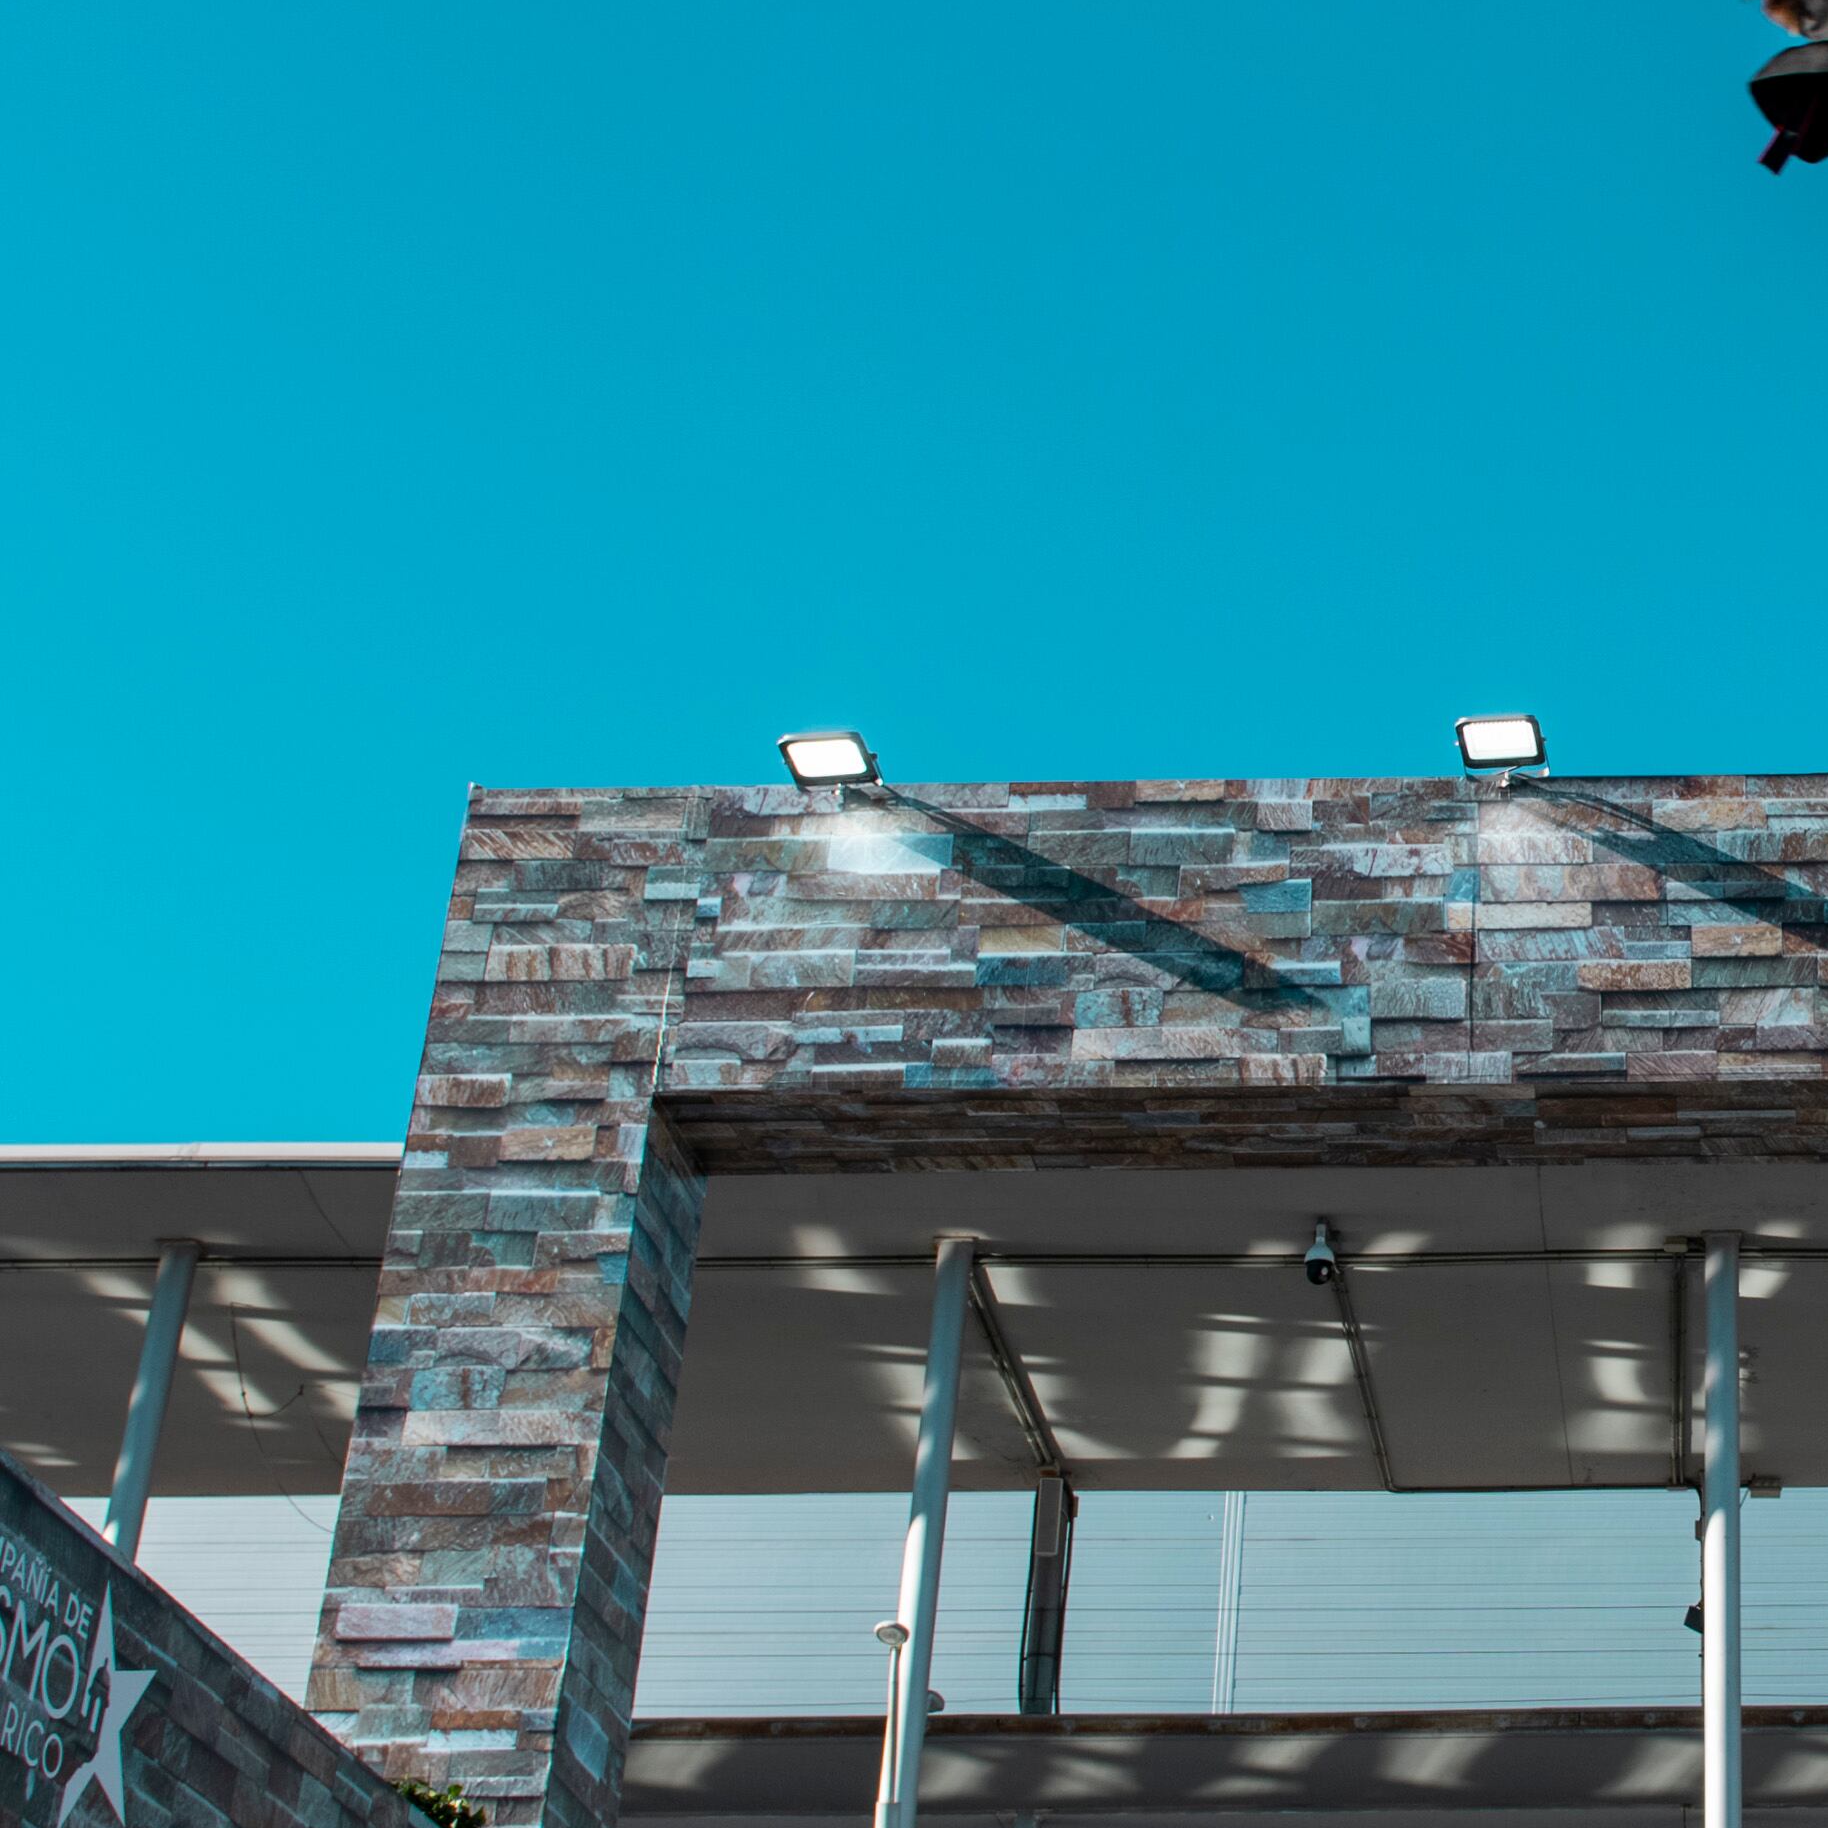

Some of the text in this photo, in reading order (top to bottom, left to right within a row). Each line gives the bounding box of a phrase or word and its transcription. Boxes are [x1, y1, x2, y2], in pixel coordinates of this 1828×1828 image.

[0, 1534, 95, 1641] PAÑÍA DE
[0, 1700, 64, 1780] RICO
